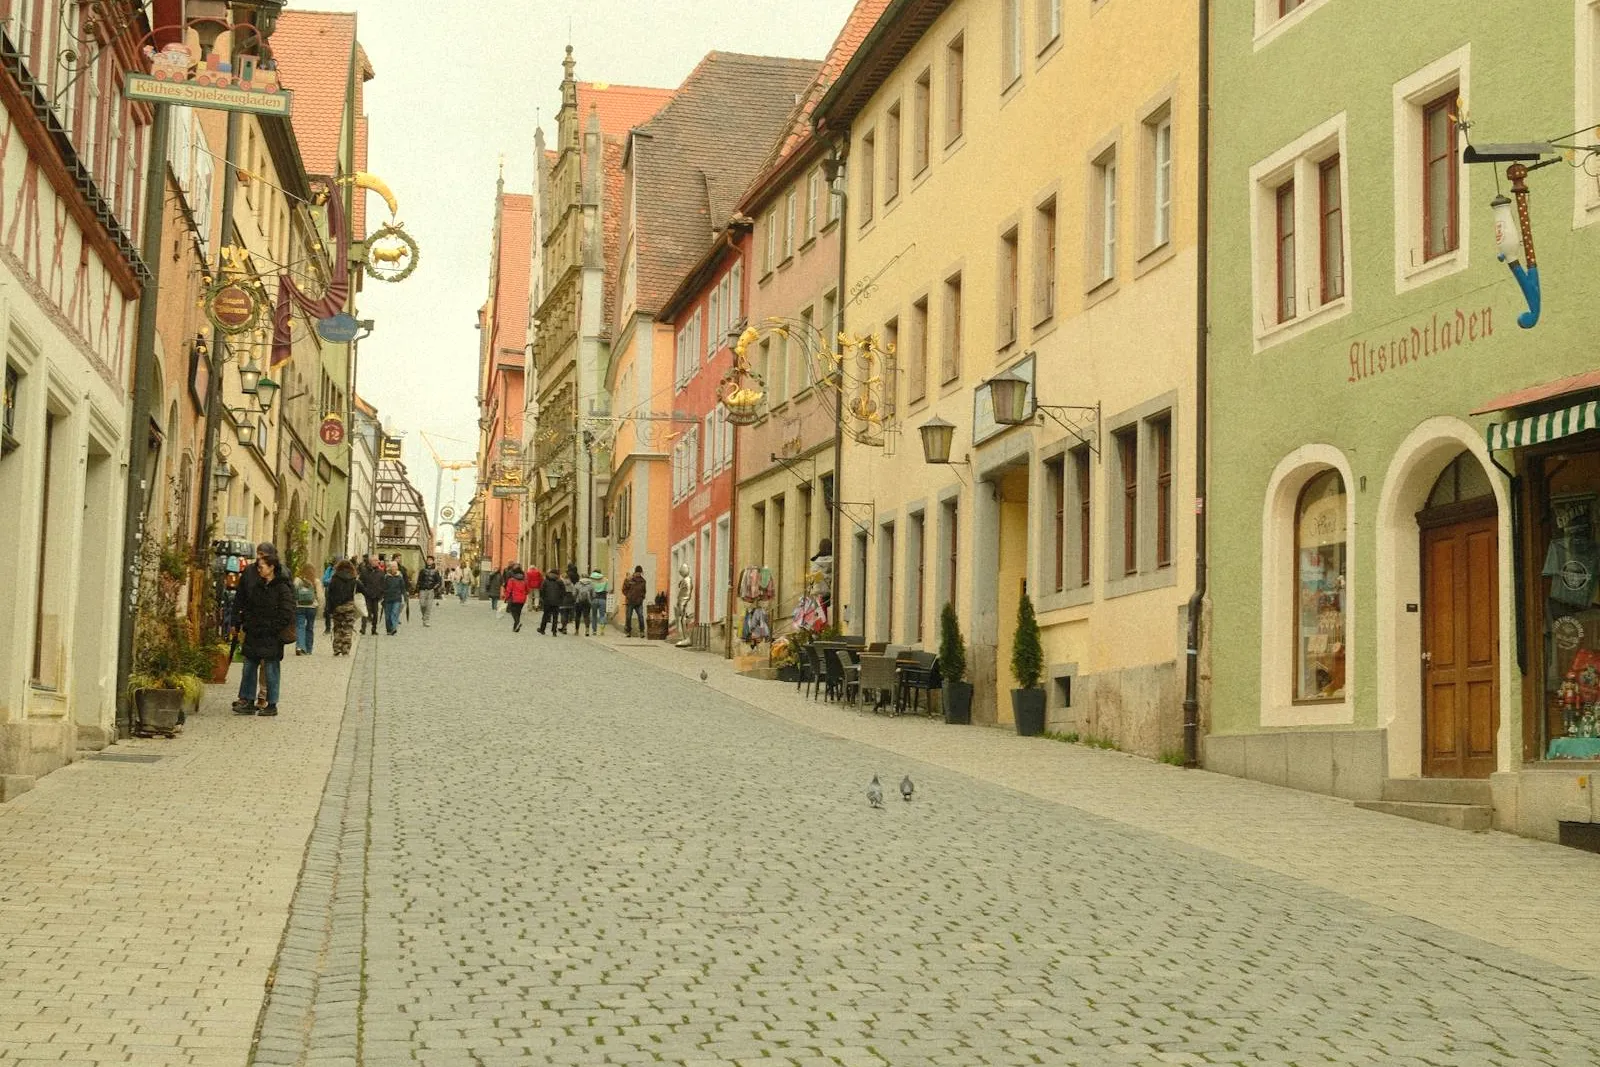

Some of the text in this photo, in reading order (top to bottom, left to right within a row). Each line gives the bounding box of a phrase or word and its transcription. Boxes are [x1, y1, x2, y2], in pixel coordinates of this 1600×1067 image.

[136, 80, 282, 106] Käthes Spielzeugladen
[1348, 306, 1494, 383] Altstadtladen
